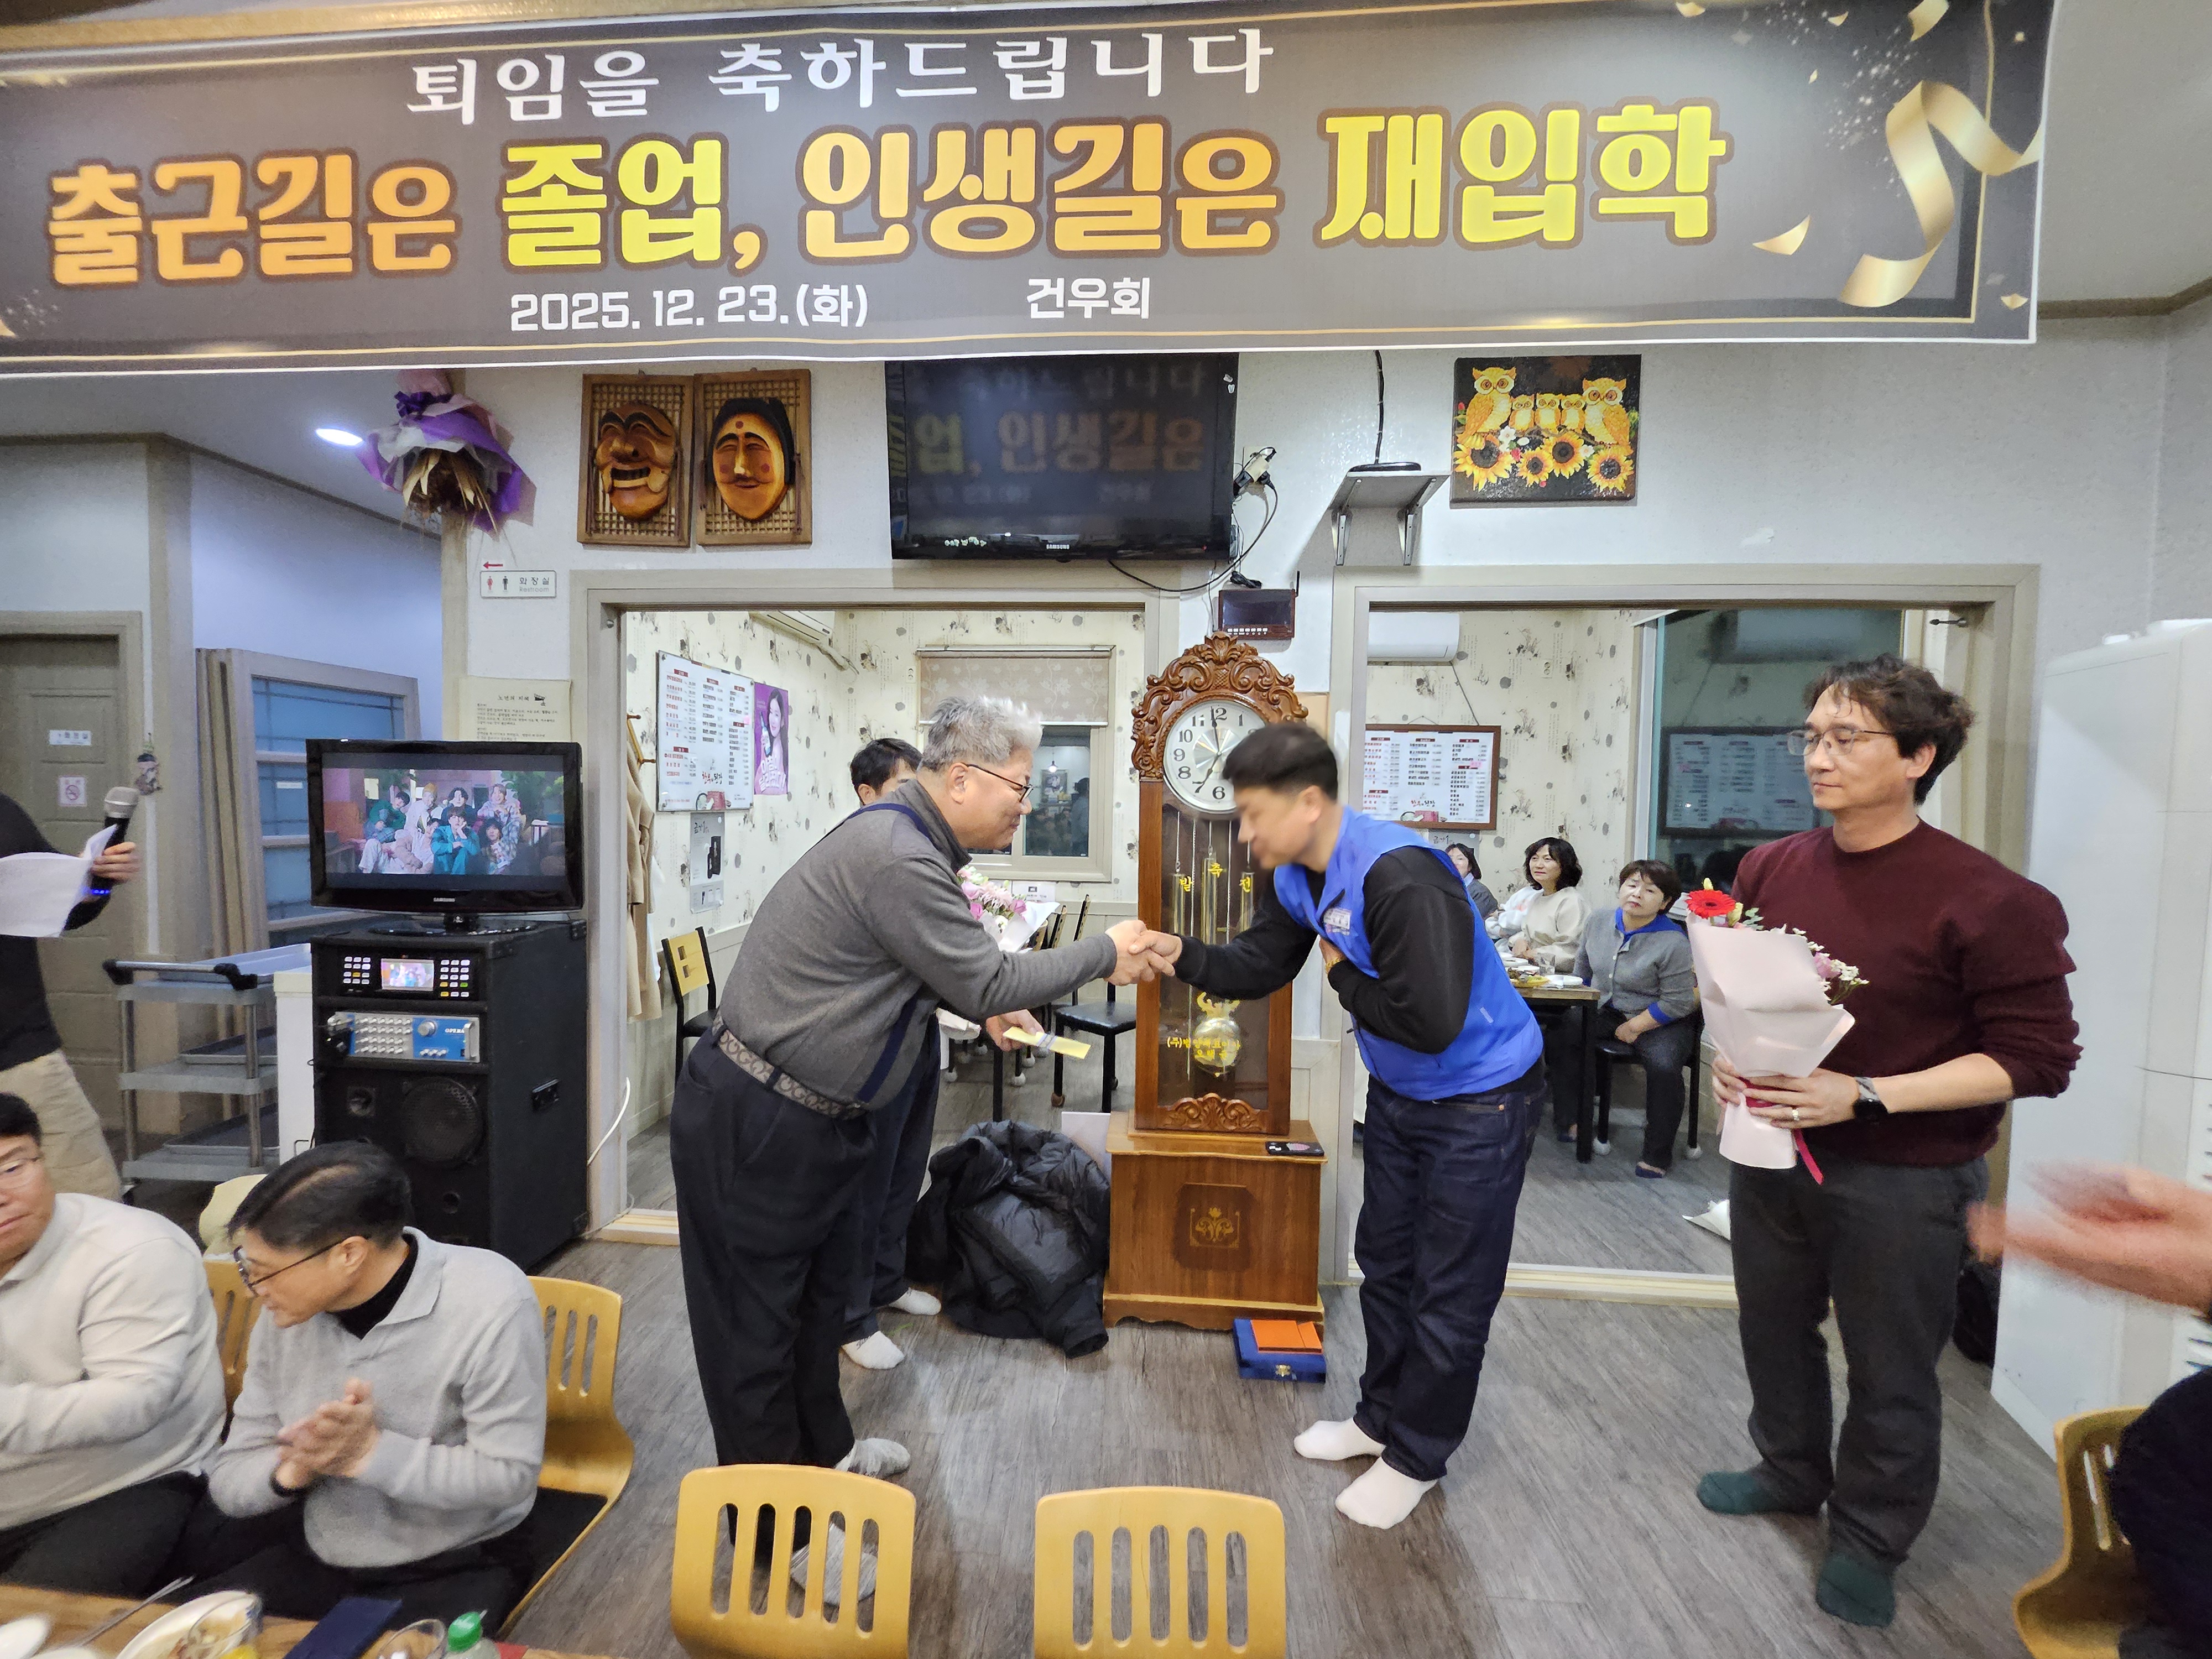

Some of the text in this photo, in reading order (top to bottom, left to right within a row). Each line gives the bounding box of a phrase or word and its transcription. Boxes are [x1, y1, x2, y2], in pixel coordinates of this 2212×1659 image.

[406, 29, 1274, 125] 퇴임을 축하드립니다
[48, 104, 1726, 285] 출근길은 졸업, 인생길은 재입학
[512, 290, 641, 331] 2025.
[654, 288, 705, 326] 12.
[1026, 277, 1150, 320] 건우회
[519, 577, 549, 586] 화장실
[1211, 707, 1227, 720] 12
[1239, 713, 1243, 726] 1
[1192, 714, 1204, 727] 11
[1179, 729, 1193, 743] 10
[1173, 748, 1185, 761] 9
[1178, 766, 1191, 779] 8
[1192, 781, 1205, 793] 7
[1212, 786, 1225, 800] 6
[1180, 876, 1250, 893] 발 전
